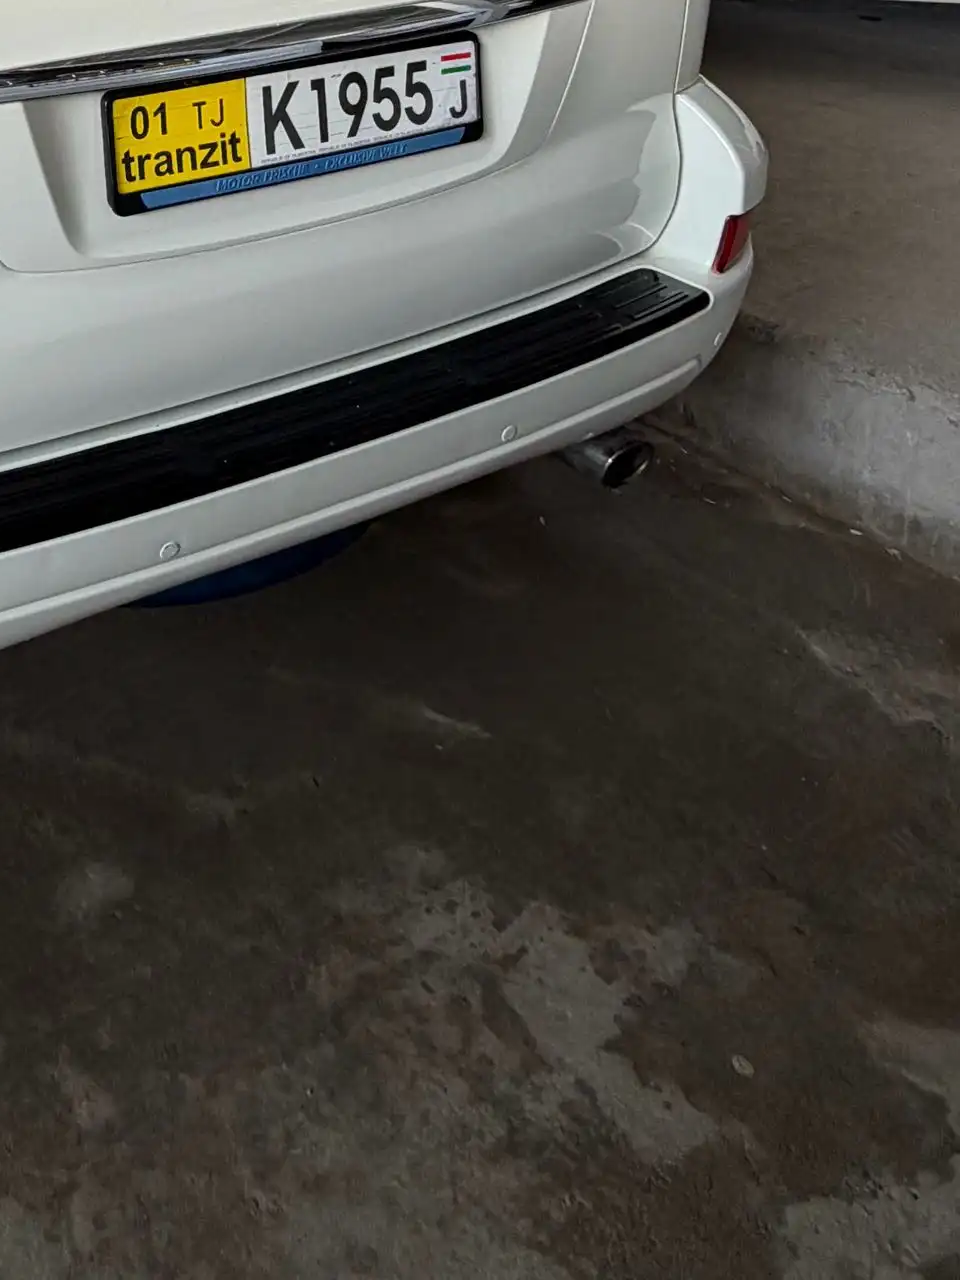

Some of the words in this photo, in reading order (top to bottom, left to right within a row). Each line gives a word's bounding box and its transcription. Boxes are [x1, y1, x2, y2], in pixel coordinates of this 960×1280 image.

[130, 102, 167, 139] 01
[193, 99, 225, 129] TJ
[261, 60, 433, 155] K1955
[449, 79, 468, 119] J
[121, 133, 242, 182] tranzit
